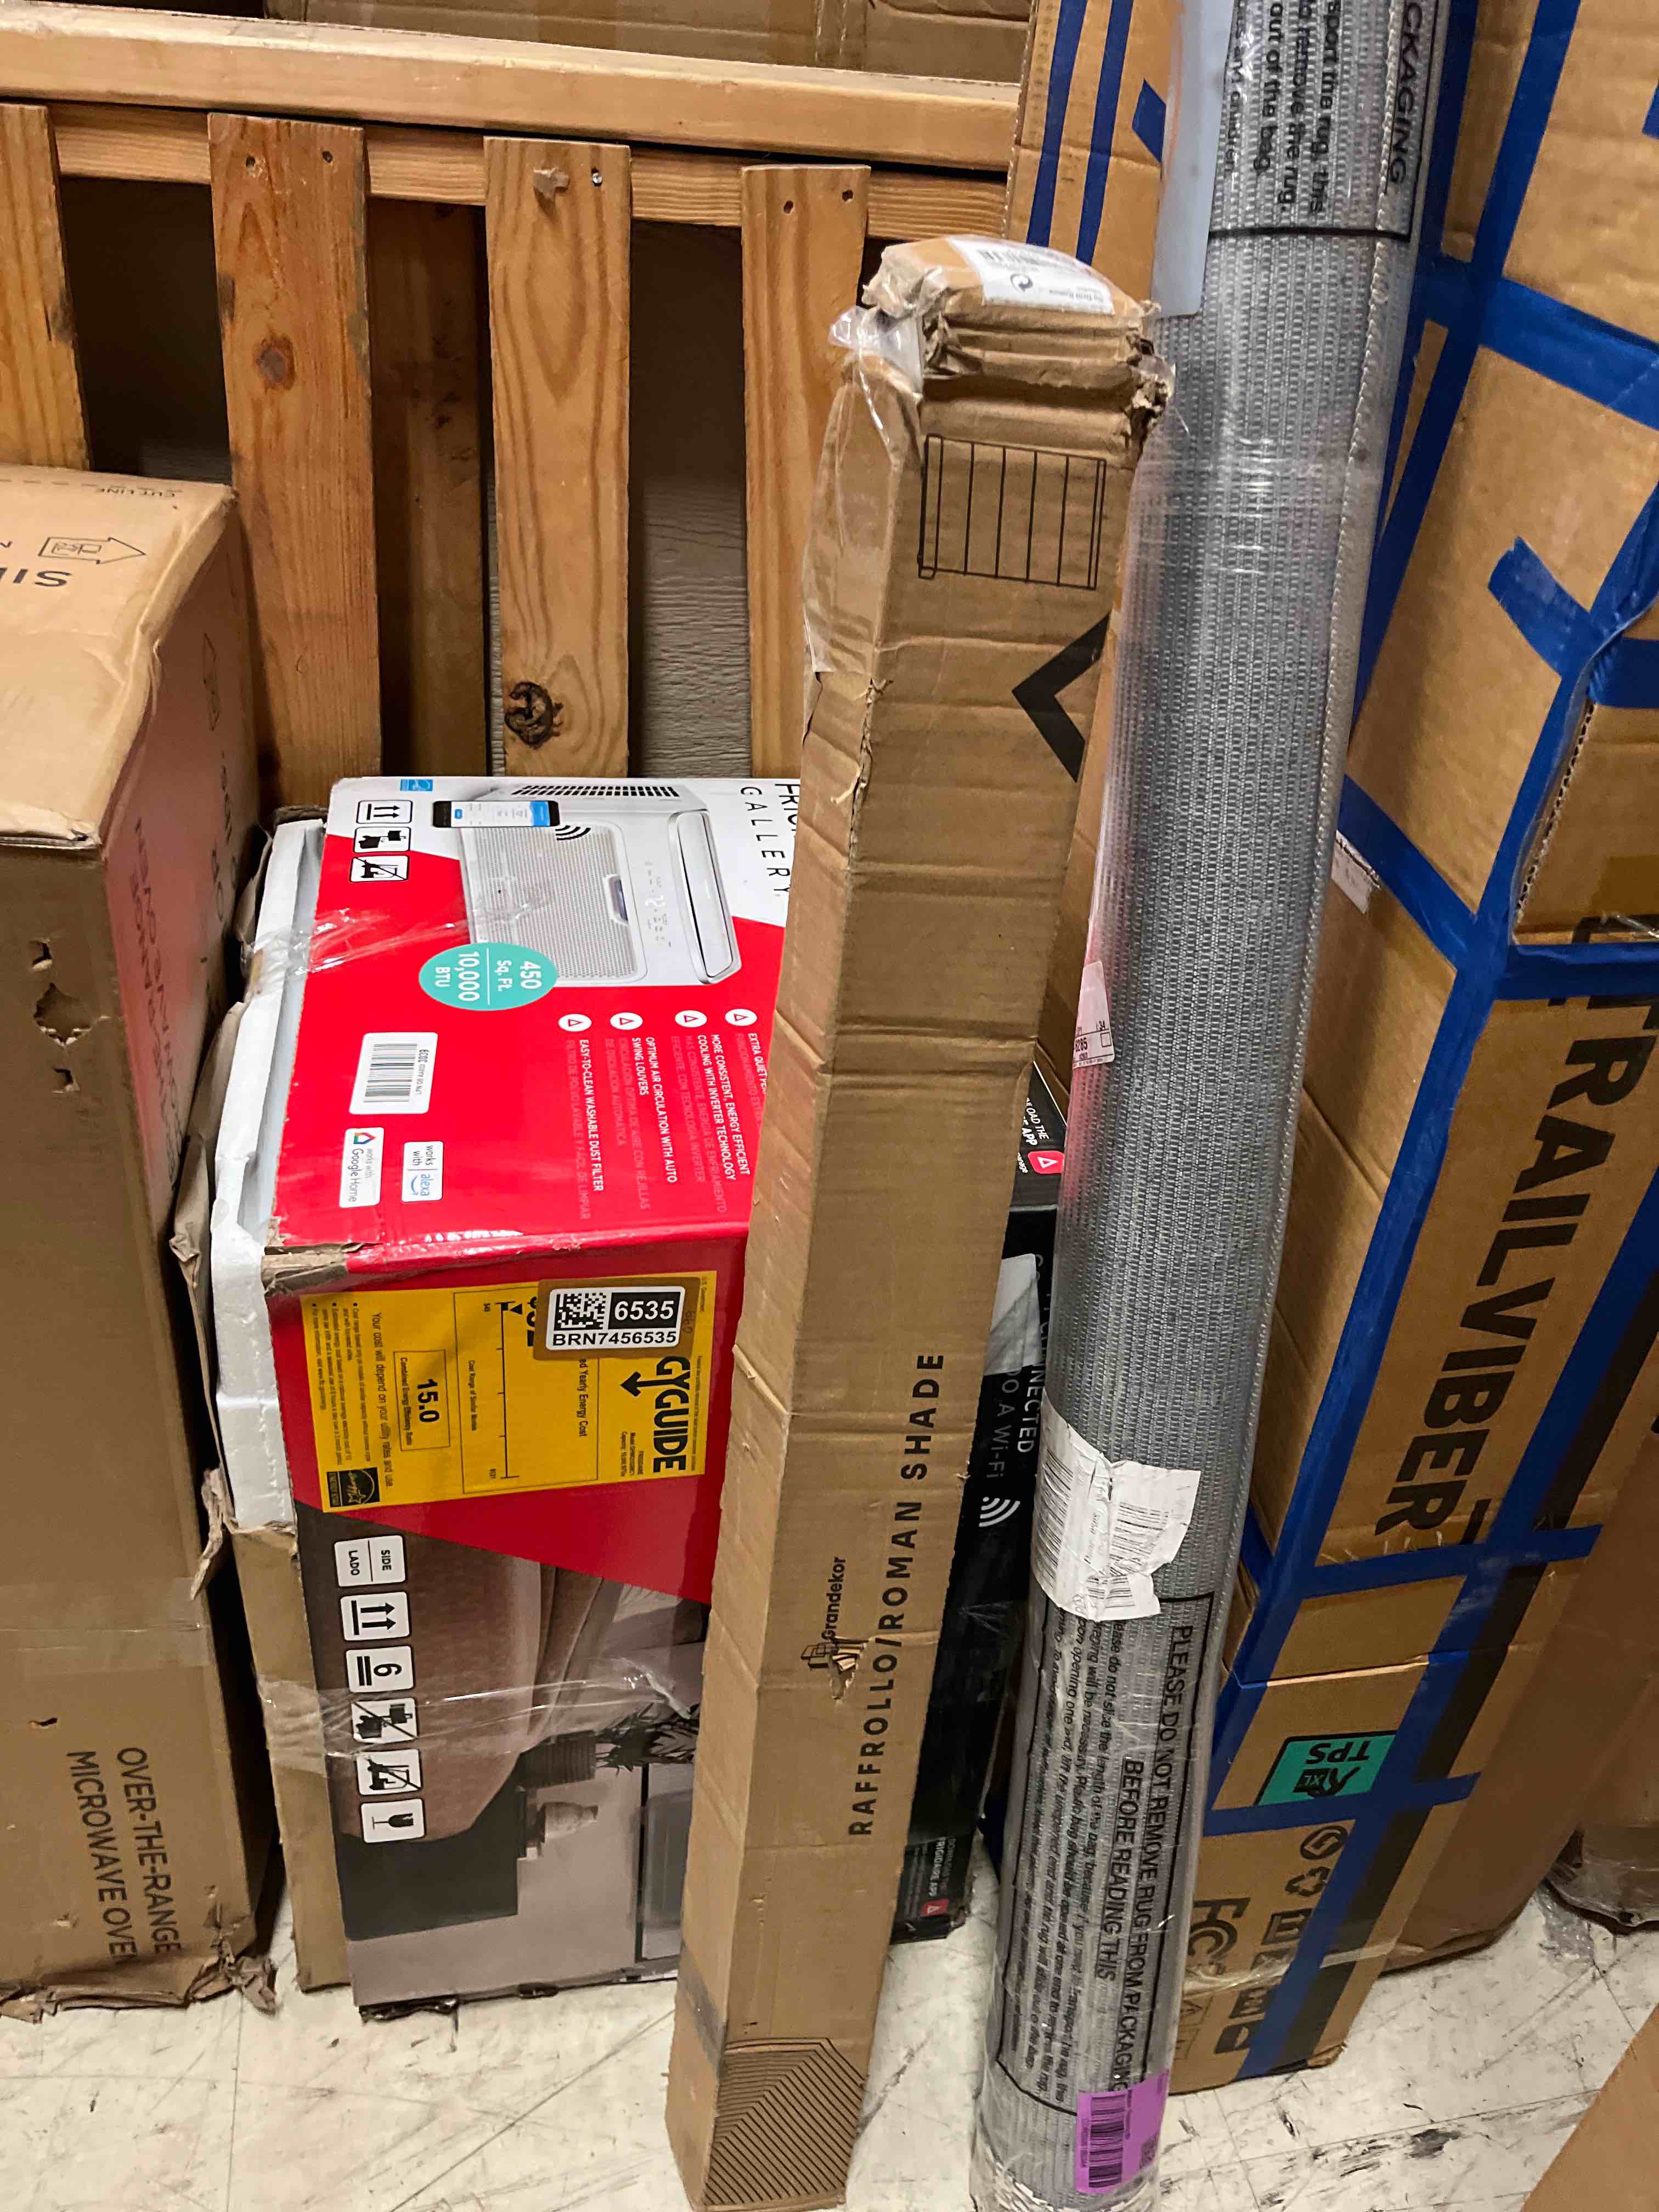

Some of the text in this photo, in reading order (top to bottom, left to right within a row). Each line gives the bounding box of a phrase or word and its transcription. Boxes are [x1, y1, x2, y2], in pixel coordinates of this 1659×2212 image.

[741, 786, 791, 893] GALLERY
[435, 966, 451, 988] BTU
[454, 951, 481, 1001] 10,000
[494, 960, 513, 992] Sq. Ft.
[520, 961, 543, 990] 450
[711, 1034, 724, 1053] MORE
[748, 1032, 767, 1076] EXTRA QUIET
[631, 1036, 650, 1096] SWING LOUVERS
[579, 1039, 604, 1192] EASY-TO-CLEAN WASHABLE DUST FILTER
[645, 1036, 678, 1184] OPTIMUM AIR CIRCULATION WITH AUTO
[697, 1035, 736, 1181] COOLING WITH INVERTER TECHNOLOGY
[725, 1102, 741, 1133] ENERGY
[1022, 1127, 1038, 1146] APP
[1035, 1125, 1049, 1140] THE
[412, 1150, 421, 1166] with
[425, 1145, 434, 1166] works
[732, 1133, 751, 1175] EFFICIENT
[347, 1148, 364, 1203] Google Home
[420, 1173, 431, 1197] alexa
[373, 1312, 383, 1330] Your
[614, 1300, 675, 1321] 6535
[374, 1331, 384, 1347] cost
[552, 1331, 677, 1346] BRN7456535
[375, 1350, 385, 1363] will
[375, 1364, 387, 1392] depend
[376, 1405, 388, 1421] your
[378, 1394, 387, 1405] on
[417, 1378, 440, 1424] 15.0
[575, 1370, 588, 1438] Yearly Energy Cost
[997, 1403, 1015, 1417] A
[382, 1441, 392, 1458] rates
[986, 1425, 1012, 1479] Wi-Fi
[383, 1459, 394, 1472] and
[348, 1550, 360, 1576] LADO
[380, 1549, 392, 1571] SIDE
[822, 1556, 847, 1641] Grandekor
[848, 1352, 944, 1836] RAFFROLLO/ROMAN SHADE
[373, 1662, 402, 1678] 6
[1066, 1646, 1083, 1698] opening
[1085, 1665, 1098, 1689] will
[1108, 1656, 1122, 1673] do
[1161, 1625, 1193, 1706] PLEASE
[1084, 1690, 1097, 1708] be
[1104, 1675, 1118, 1698] not
[1063, 1700, 1075, 1724] one
[1101, 1700, 1115, 1729] slice
[1159, 1711, 1180, 1742] DO
[1098, 1730, 1113, 1752] the
[1306, 1740, 1372, 1765] TPS
[1153, 1749, 1176, 1790] NOT
[66, 1750, 128, 1902] MICROWAVE
[1139, 1796, 1169, 1880] REMOVE
[116, 1747, 182, 1954] OVER-THE-RANGE
[1097, 1759, 1144, 1982] BEFORE READING THIS
[1132, 1885, 1156, 1928] RUG
[1123, 1932, 1149, 1988] FROM
